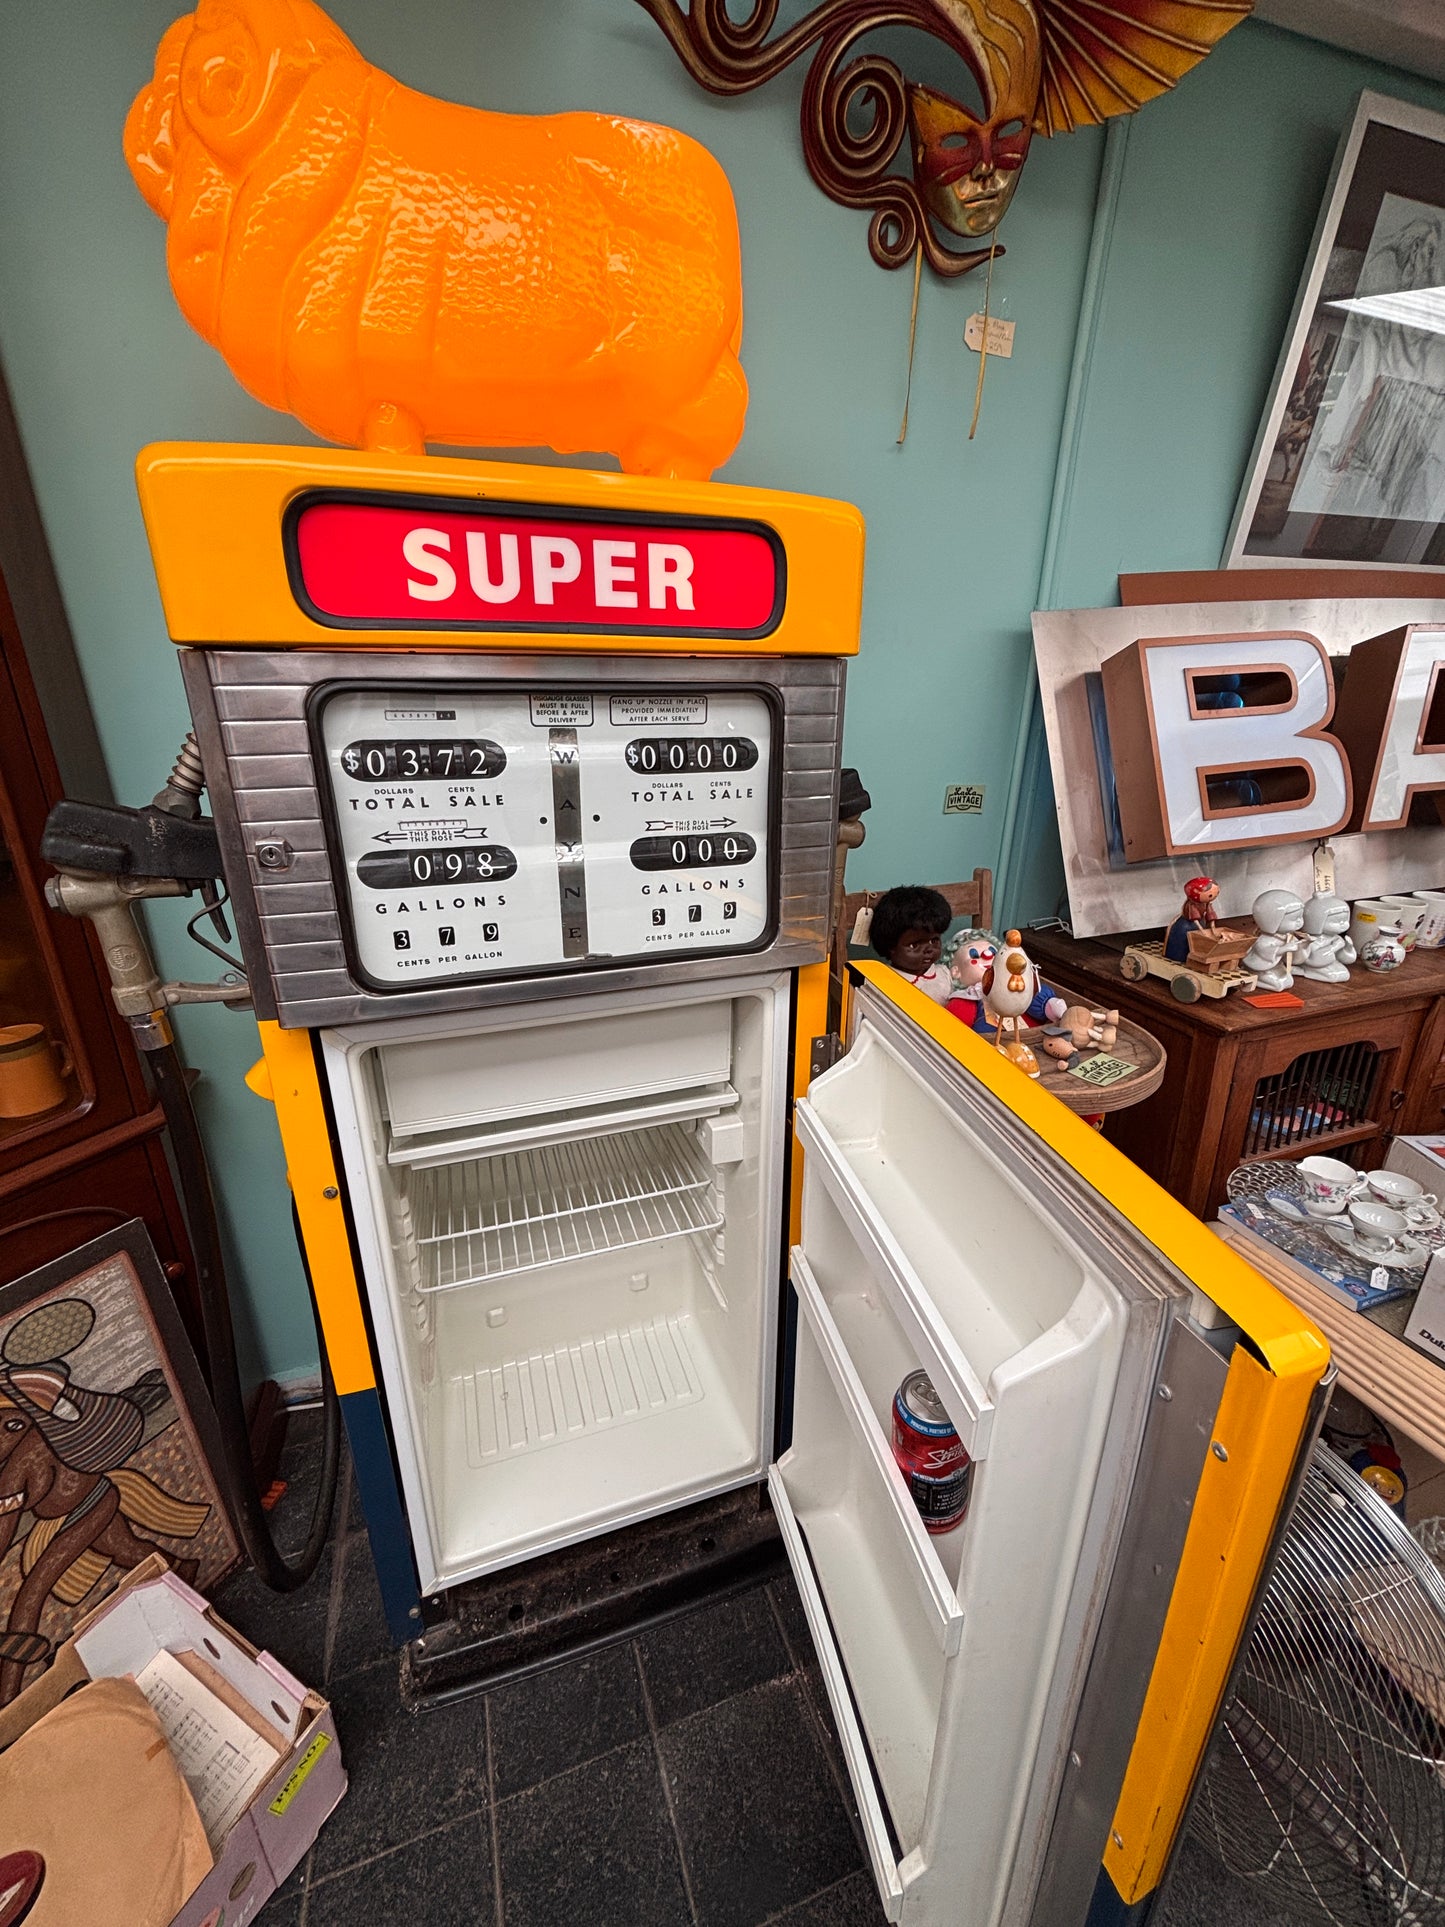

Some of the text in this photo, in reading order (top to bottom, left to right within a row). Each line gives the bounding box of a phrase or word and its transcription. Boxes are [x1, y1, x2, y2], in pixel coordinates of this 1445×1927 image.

[402, 527, 696, 611] SUPER
[374, 787, 414, 795] DOLLARS
[631, 788, 753, 802] TOTAL SALE
[349, 794, 505, 811] TOTAL SALE
[949, 795, 980, 805] VINTAGE
[554, 750, 582, 939] WAYNE
[641, 878, 745, 895] GALLONS
[375, 895, 506, 914] GALLONS
[700, 928, 731, 936] GALLON
[397, 951, 503, 967] CENTS PER GALLON
